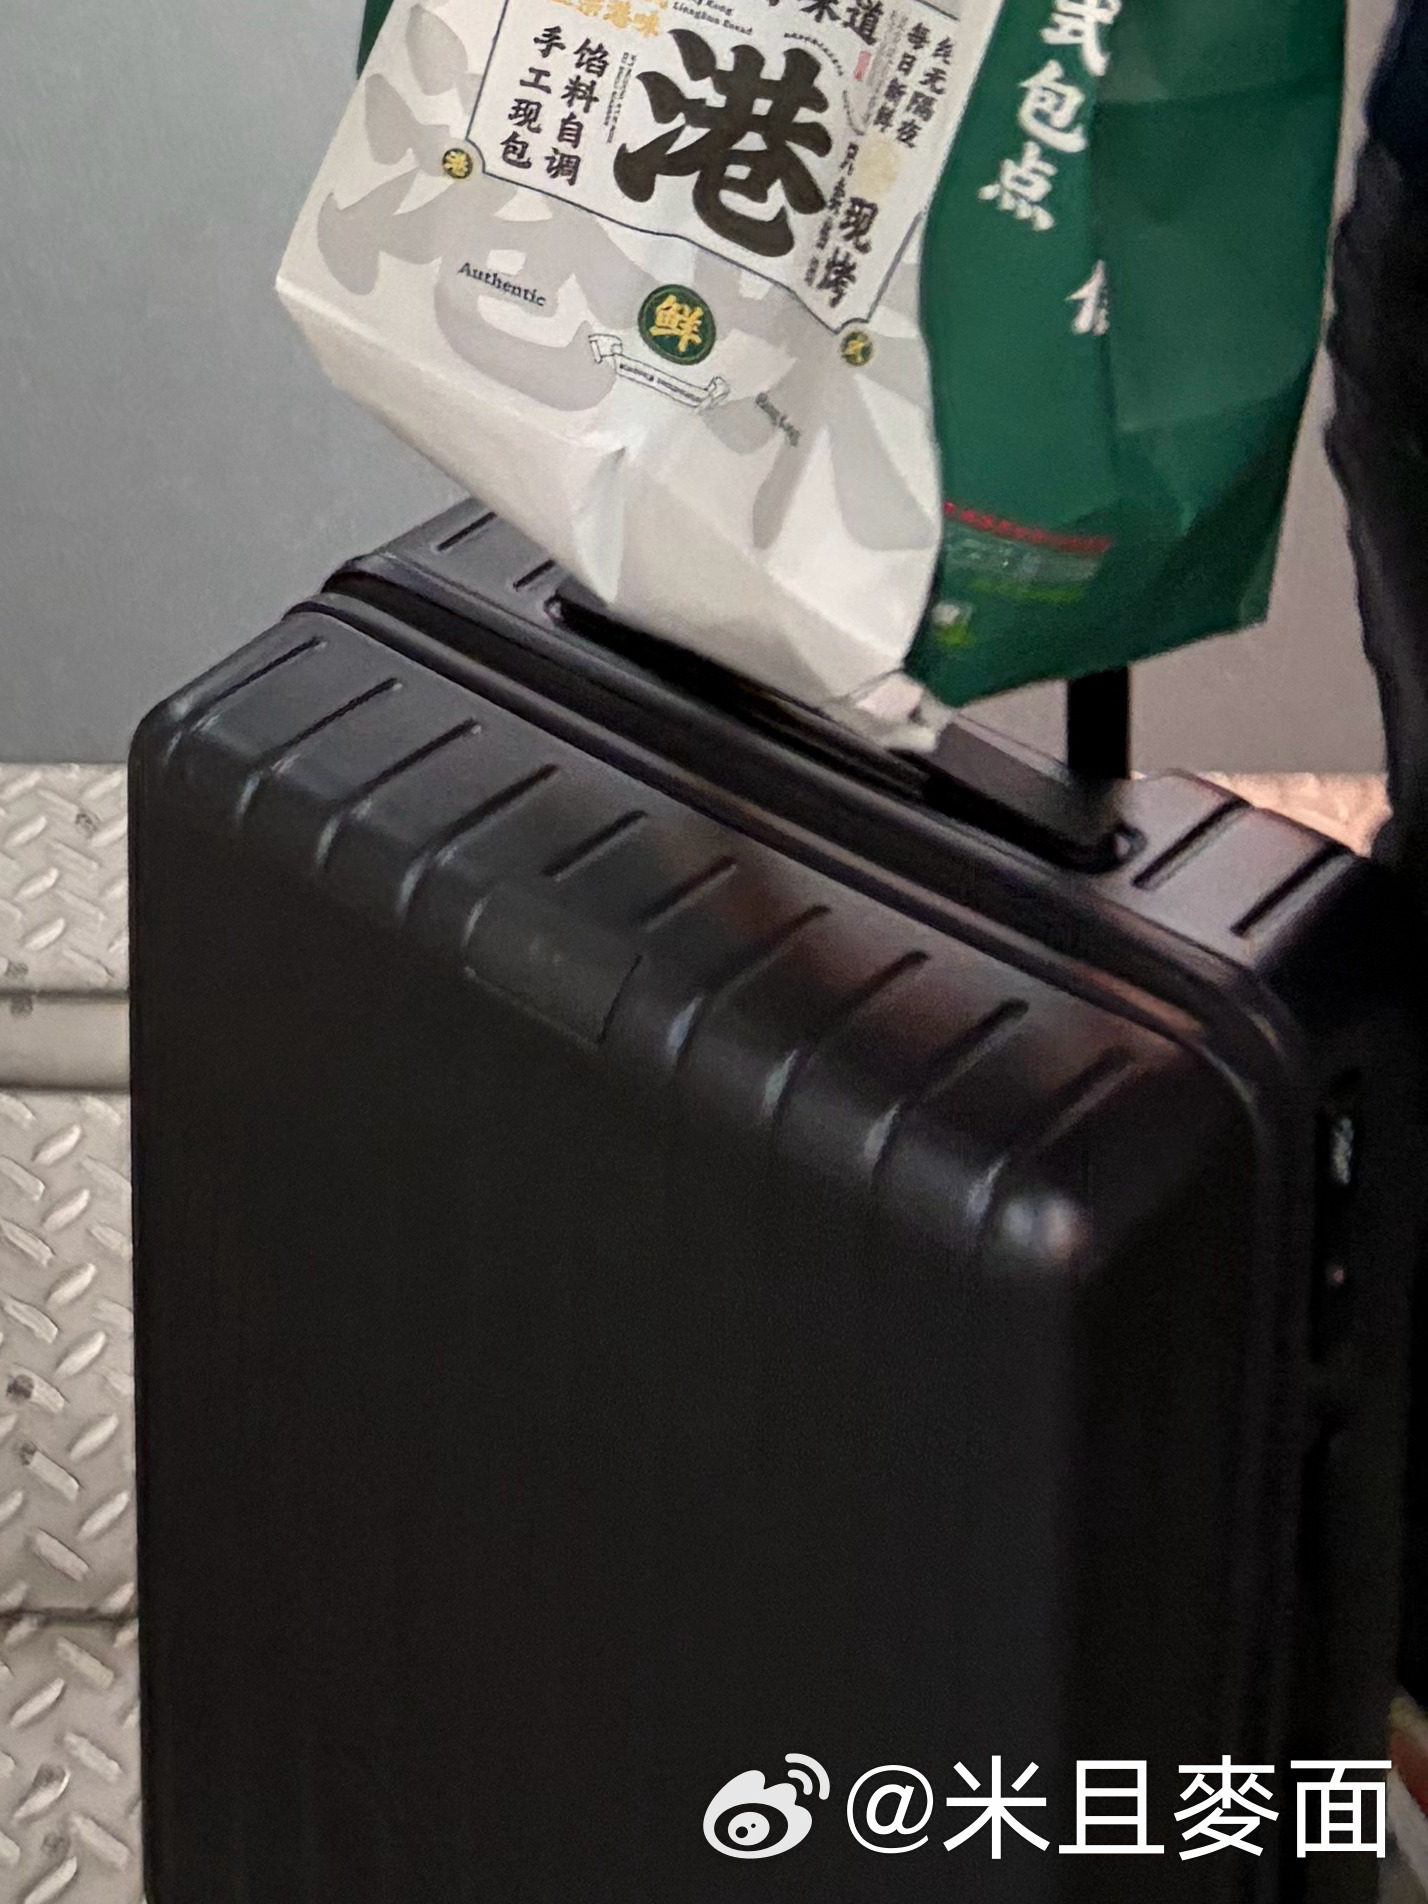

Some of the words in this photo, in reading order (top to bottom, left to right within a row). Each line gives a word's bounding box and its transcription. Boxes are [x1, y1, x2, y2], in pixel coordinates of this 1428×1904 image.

[500, 25, 566, 169] 手工现包
[544, 38, 610, 186] 馅料自调
[613, 28, 833, 258] 港
[457, 261, 547, 307] Authentic
[649, 294, 704, 353] 鲜
